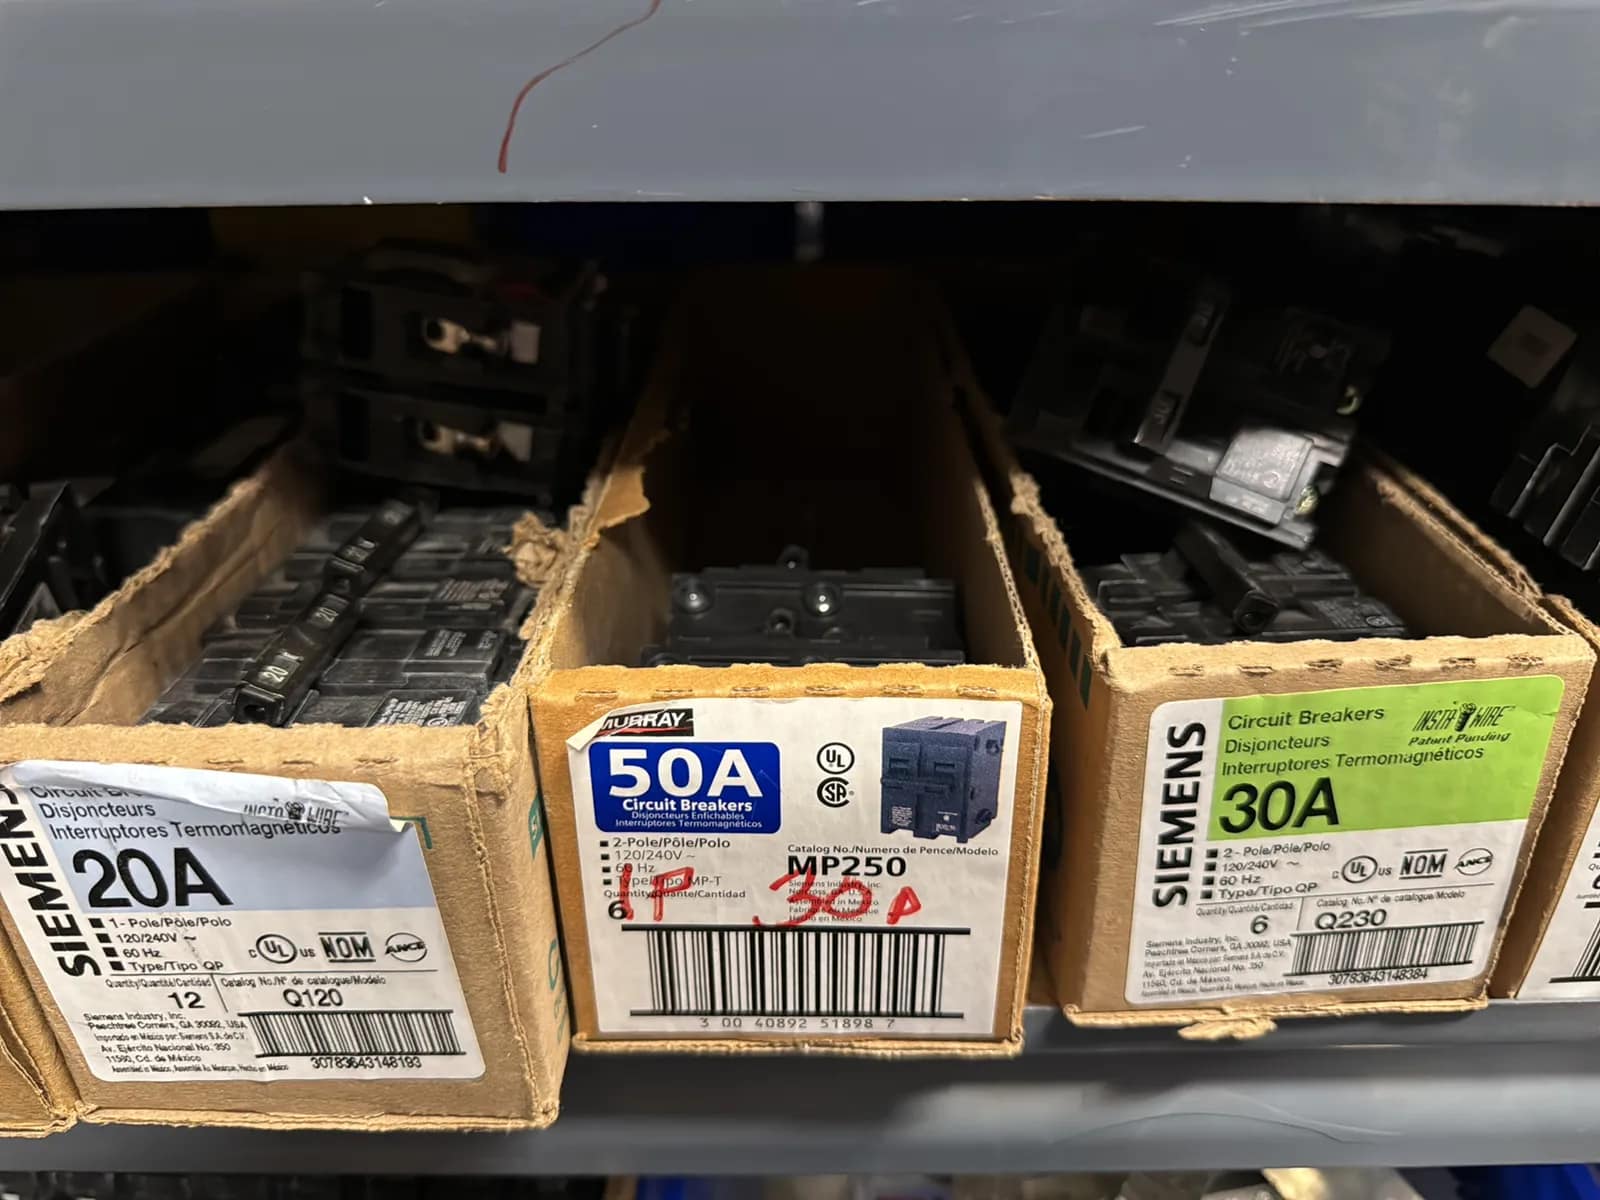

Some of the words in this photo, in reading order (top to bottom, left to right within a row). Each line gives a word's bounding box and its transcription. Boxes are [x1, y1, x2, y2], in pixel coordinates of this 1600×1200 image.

[259, 665, 290, 683] 20
[1228, 711, 1292, 730] Circuit
[1299, 706, 1385, 725] Breakers
[1225, 735, 1330, 755] Disjoncteurs
[1408, 735, 1453, 746] Patent
[1455, 731, 1512, 743] Pending
[1222, 757, 1329, 776] Interruptores
[1335, 746, 1485, 768] Termomagnéticos
[608, 748, 764, 798] 50A
[39, 802, 156, 822] Disjoncteurs
[622, 798, 677, 811] Circuit
[680, 798, 753, 812] Breakers
[1219, 777, 1340, 834] 30A
[631, 811, 689, 821] Disjoncteurs
[691, 811, 745, 821] Enfichables
[1152, 721, 1206, 908] SIEMENS
[615, 819, 676, 829] Interruptores
[679, 818, 763, 829] Termomagnéticos
[50, 822, 169, 842] Interruptores
[612, 836, 731, 848] 2-Pole/Pôle/Polo
[787, 843, 830, 855] Catalog
[833, 845, 901, 855] No./Numero
[903, 846, 917, 855] de
[919, 846, 999, 857] Pence/Modelo
[615, 850, 683, 860] 120/240V
[637, 863, 656, 873] Hz
[787, 855, 907, 877] MP250
[1222, 859, 1279, 873] 120/240V
[1400, 854, 1447, 876] NOM
[73, 847, 234, 908] 20A
[1219, 875, 1238, 886] 60
[1241, 874, 1261, 885] Hz
[1218, 886, 1293, 900] Type/Tipo
[1294, 882, 1318, 894] QP
[1317, 898, 1348, 907] Catalog
[1380, 893, 1391, 903] de
[608, 899, 628, 920] 6
[127, 916, 232, 928] Pole/Pôle/Polo
[1250, 914, 1270, 935] 6
[1315, 908, 1388, 931] Q230
[116, 933, 178, 944] 120/240V
[122, 949, 140, 958] 60
[144, 949, 163, 958] Hz
[319, 936, 376, 959] NOM
[129, 961, 198, 973] Type/Tipo
[202, 960, 224, 971] QP
[221, 977, 256, 988] Catalog
[291, 975, 304, 985] de
[168, 991, 206, 1009] 12
[283, 987, 344, 1007] Q120
[83, 1013, 125, 1022] Siemens
[126, 1011, 168, 1022] Industry,
[168, 1011, 186, 1020] Inc.
[699, 1017, 710, 1028] 3
[721, 1017, 743, 1028] 00
[755, 1018, 808, 1029] 40892
[820, 1018, 874, 1029] 51898
[887, 1018, 896, 1029] 7
[154, 1054, 167, 1062] de
